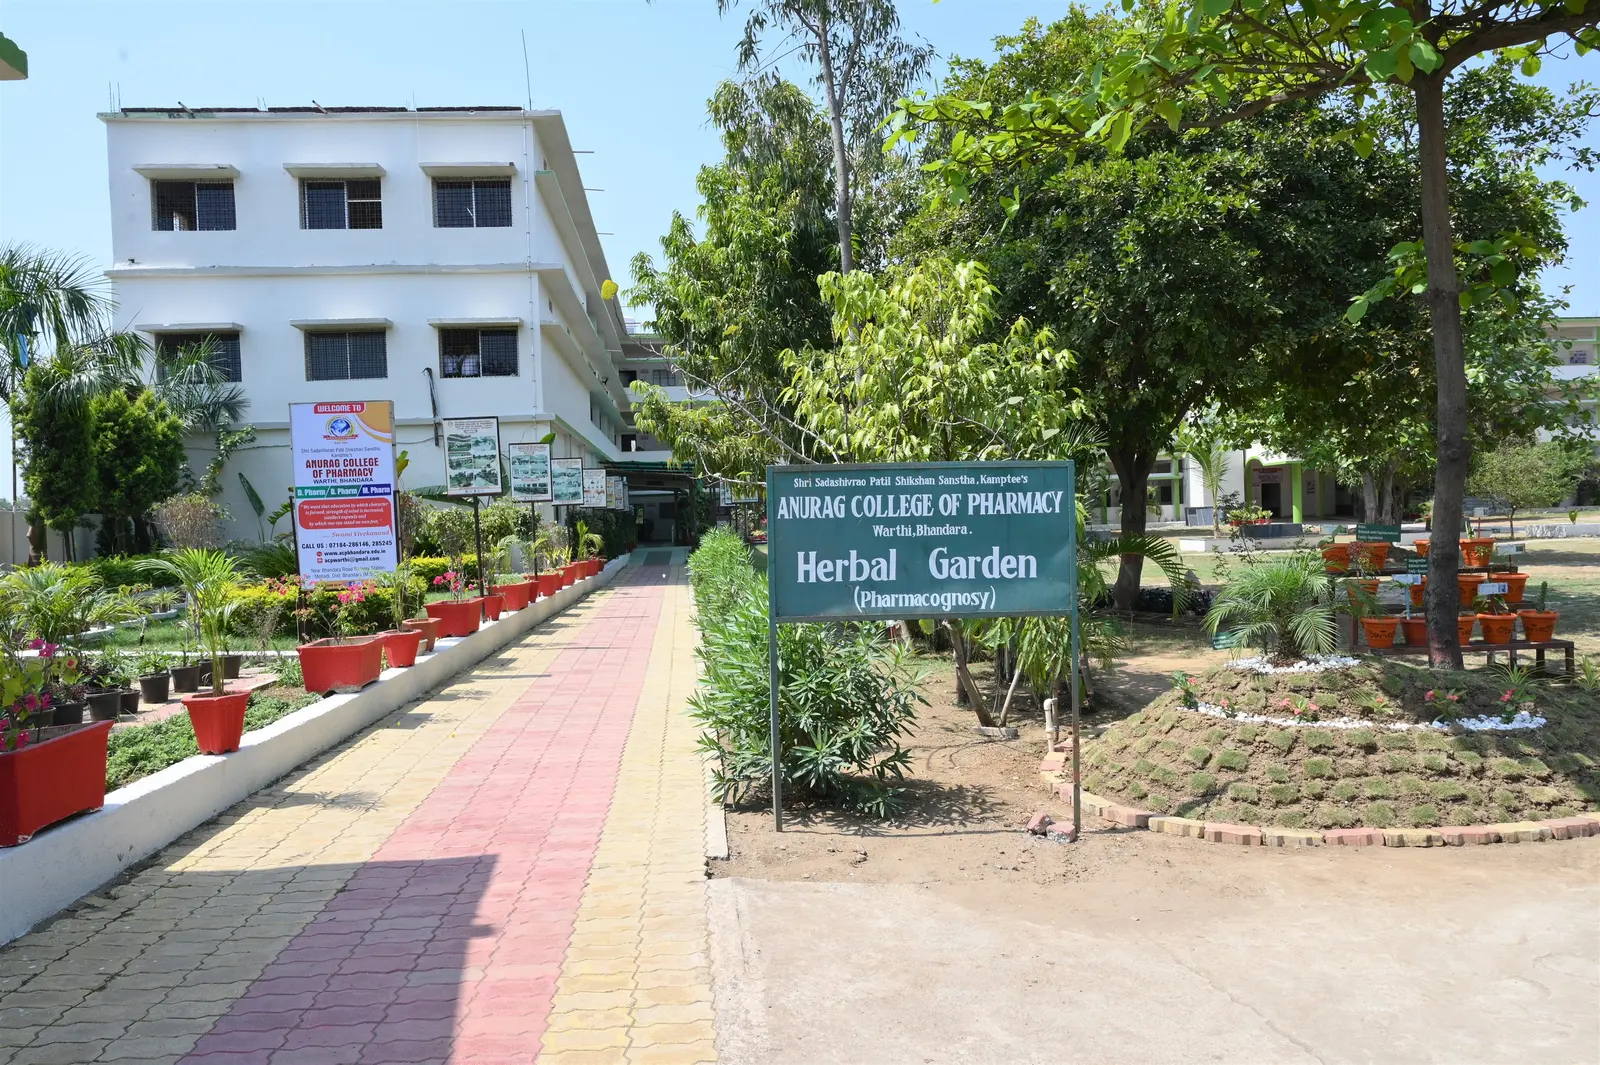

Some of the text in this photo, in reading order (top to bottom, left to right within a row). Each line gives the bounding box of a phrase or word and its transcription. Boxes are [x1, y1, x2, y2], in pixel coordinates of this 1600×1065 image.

[318, 404, 350, 412] WELCOME
[306, 458, 379, 468] ANURAG COLLEGE
[312, 468, 374, 478] OF PHARMACY
[794, 478, 812, 488] Shri
[815, 477, 866, 487] Sadashivrao
[870, 476, 891, 486] Patil
[895, 476, 936, 486] Shikshan
[777, 490, 1064, 519] ANURAG COLLEGE OF PHARMACY
[797, 546, 1037, 583] Herbal Garden
[854, 585, 996, 613] (Pharmacognosy)
